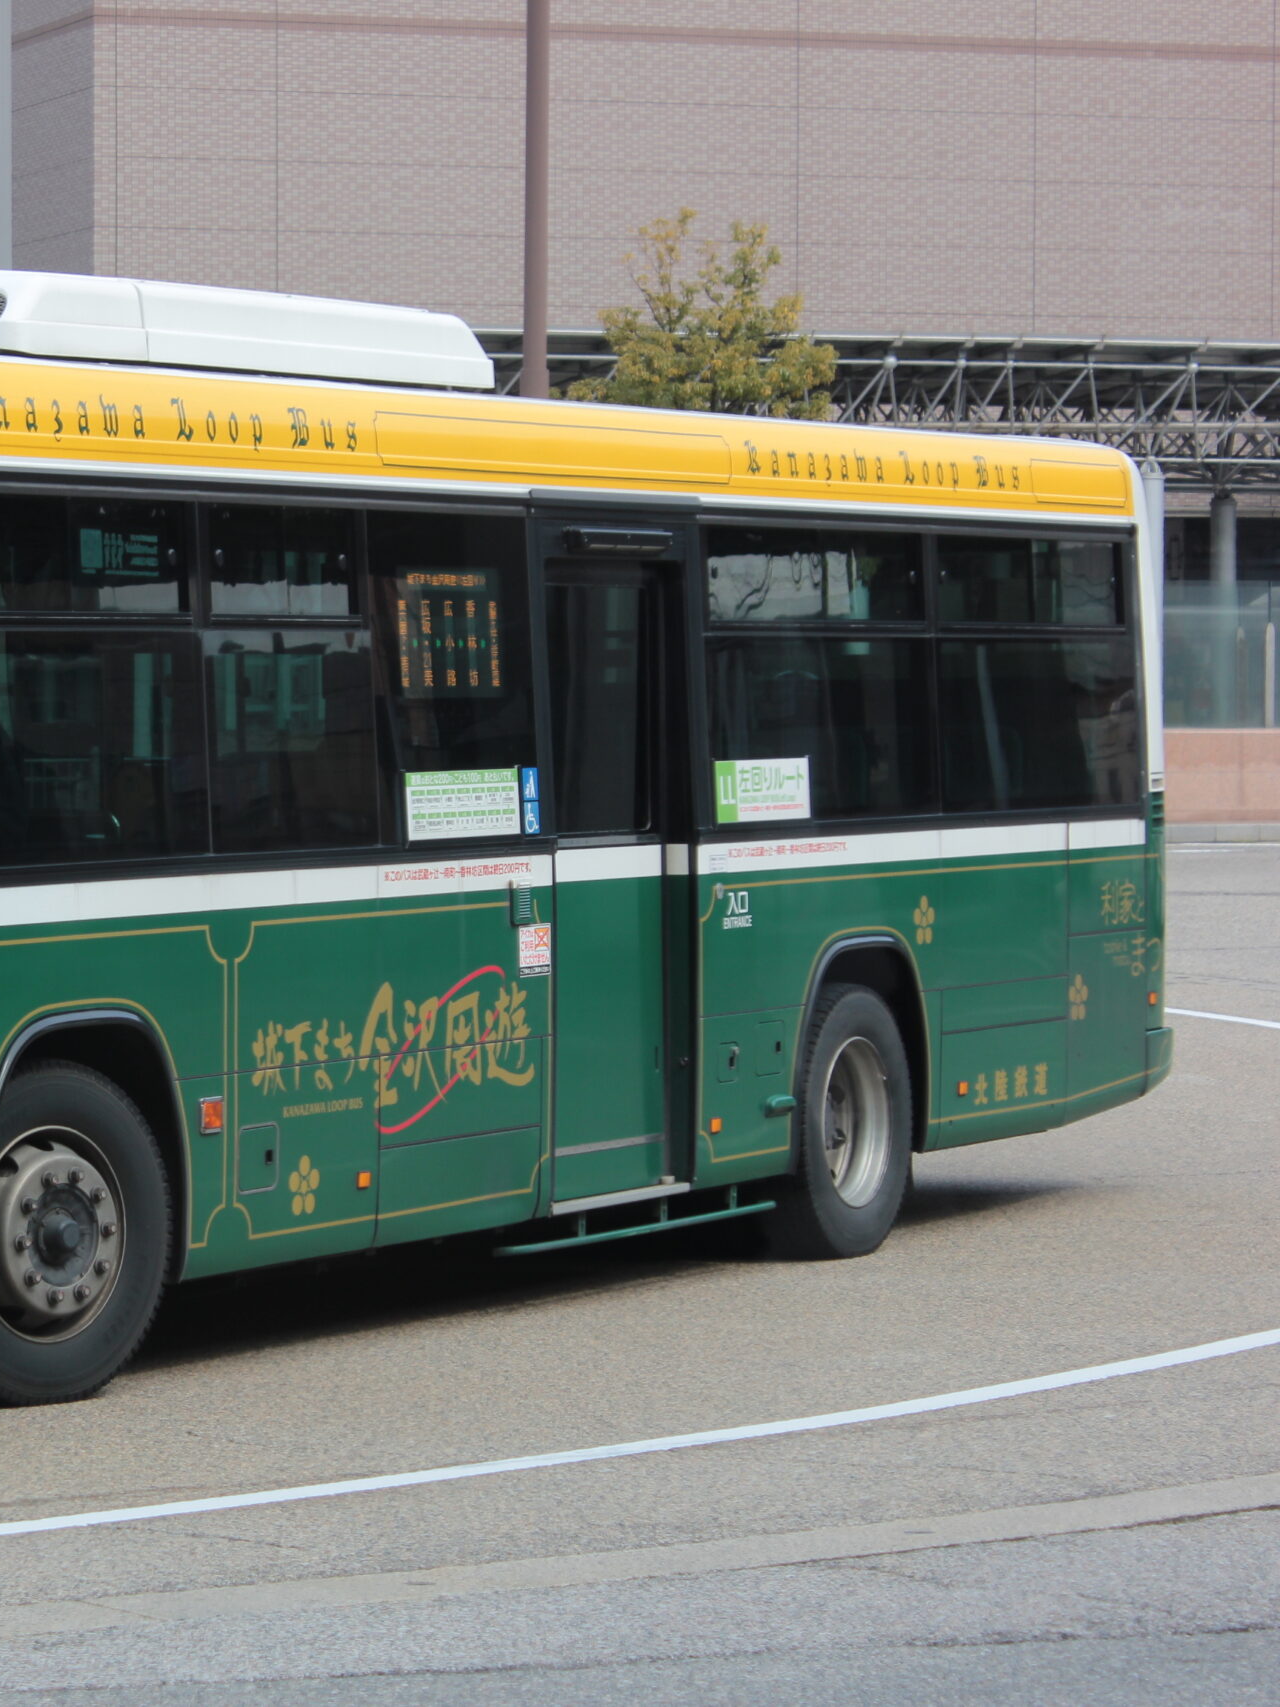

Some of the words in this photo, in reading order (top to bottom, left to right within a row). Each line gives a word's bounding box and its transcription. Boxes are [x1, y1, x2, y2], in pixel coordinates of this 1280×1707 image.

[171, 397, 262, 452] Loop
[287, 407, 357, 452] Bus
[744, 440, 884, 486] Kanazawa
[898, 450, 959, 491] Loop
[973, 455, 1020, 490] Bus
[720, 775, 737, 805] LL
[738, 764, 805, 793] 左回りルート
[727, 891, 749, 915] 入口
[723, 915, 753, 930] ENTRANCE
[283, 1102, 326, 1118] KANAZAWA
[327, 1099, 347, 1112] LOOP
[348, 1097, 364, 1110] BUS
